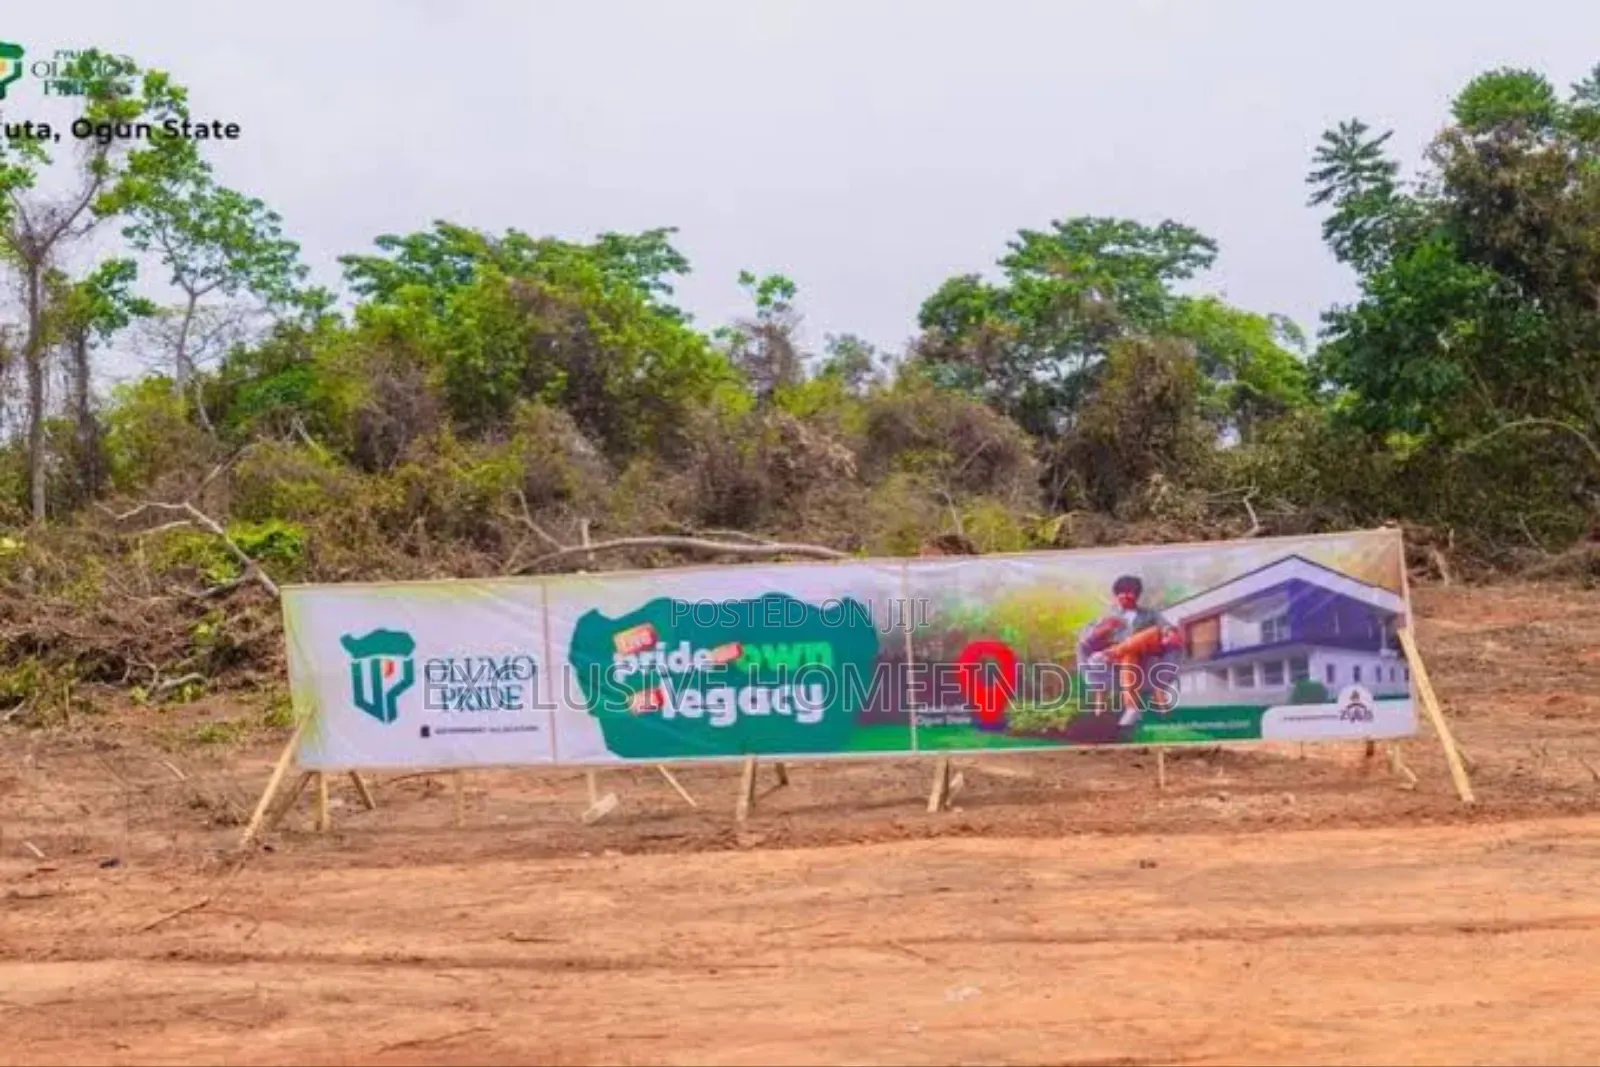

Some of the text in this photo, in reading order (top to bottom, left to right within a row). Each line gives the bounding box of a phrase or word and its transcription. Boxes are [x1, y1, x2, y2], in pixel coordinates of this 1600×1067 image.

[424, 655, 536, 683] OLUMO
[612, 640, 714, 684] pride
[736, 640, 833, 672] own
[661, 675, 824, 727] legacy
